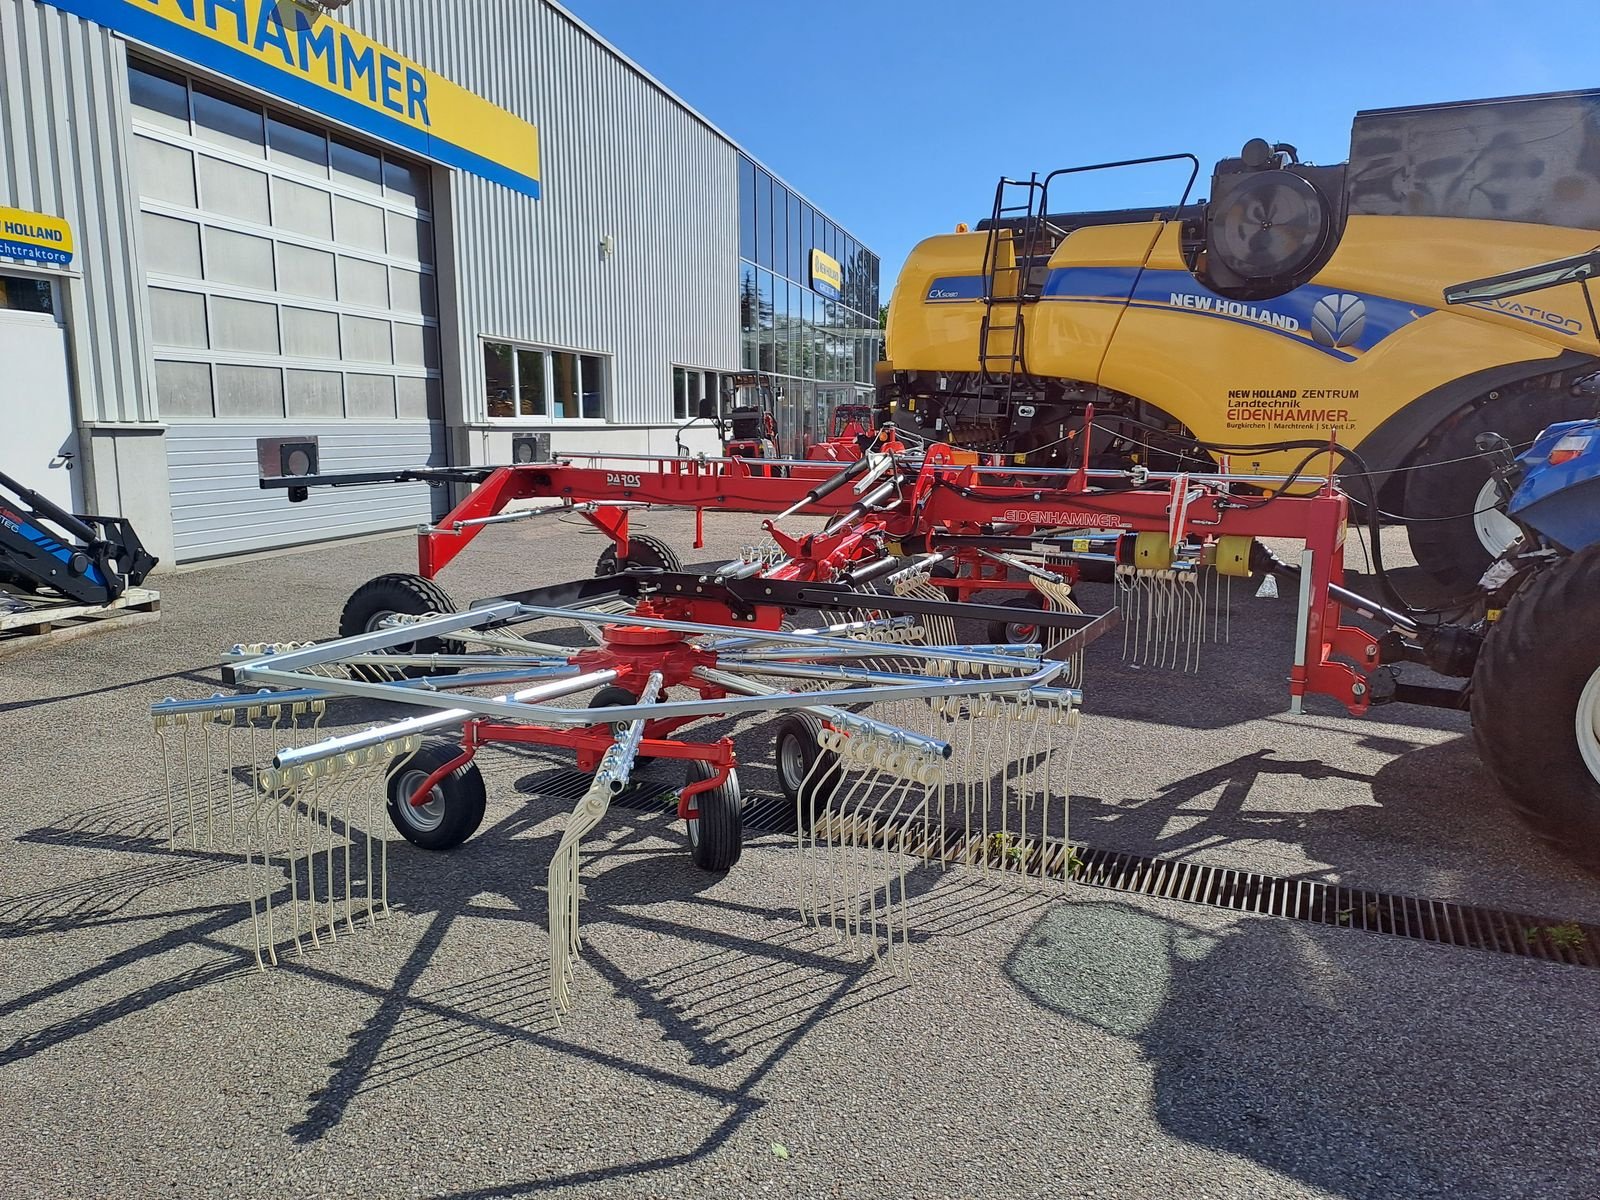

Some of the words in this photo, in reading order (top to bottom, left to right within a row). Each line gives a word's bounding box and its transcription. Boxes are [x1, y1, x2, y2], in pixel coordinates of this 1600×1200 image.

[4, 221, 63, 242] HOLLAND
[1170, 292, 1212, 311] NEW
[1215, 299, 1299, 332] HOLLAND
[1228, 390, 1251, 399] NEW
[1252, 390, 1297, 399] HOLLAND
[1301, 389, 1359, 399] ZENTRUM
[1228, 400, 1300, 408] Landtechnik
[1227, 409, 1348, 422] EIDENHAMMER
[1226, 422, 1265, 430] Burgkirchen
[1004, 509, 1121, 528] EIDENHAMMER
